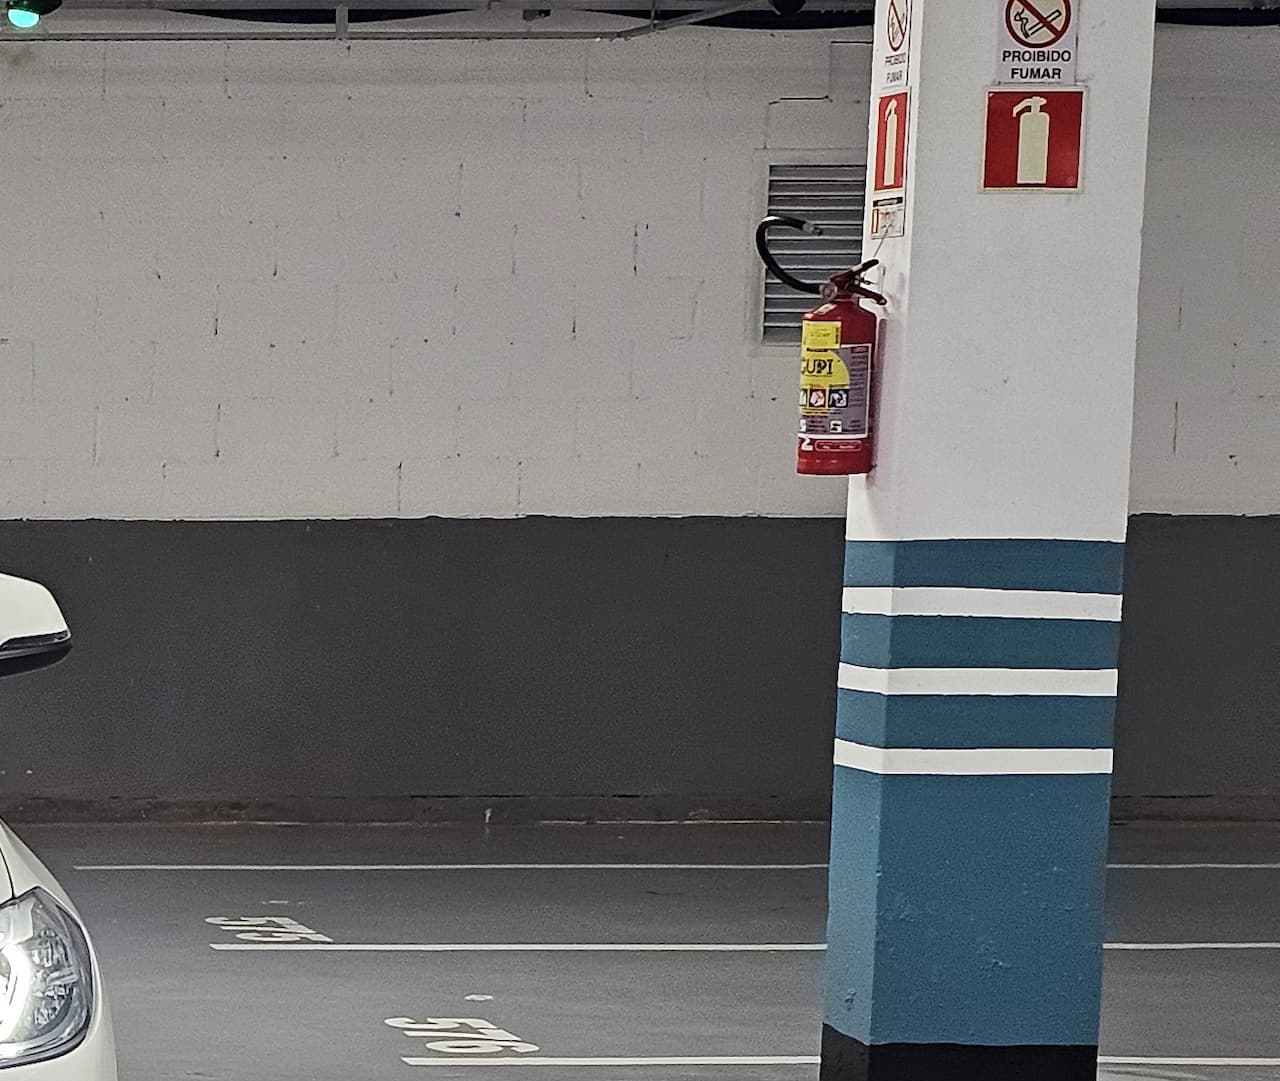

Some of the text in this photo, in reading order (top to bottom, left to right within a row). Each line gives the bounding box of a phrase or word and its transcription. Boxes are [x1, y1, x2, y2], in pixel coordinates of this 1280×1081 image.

[1002, 50, 1072, 62] PROIBIDO
[1011, 67, 1062, 79] FUMAR
[204, 916, 334, 942] 575
[383, 1017, 540, 1053] 576
